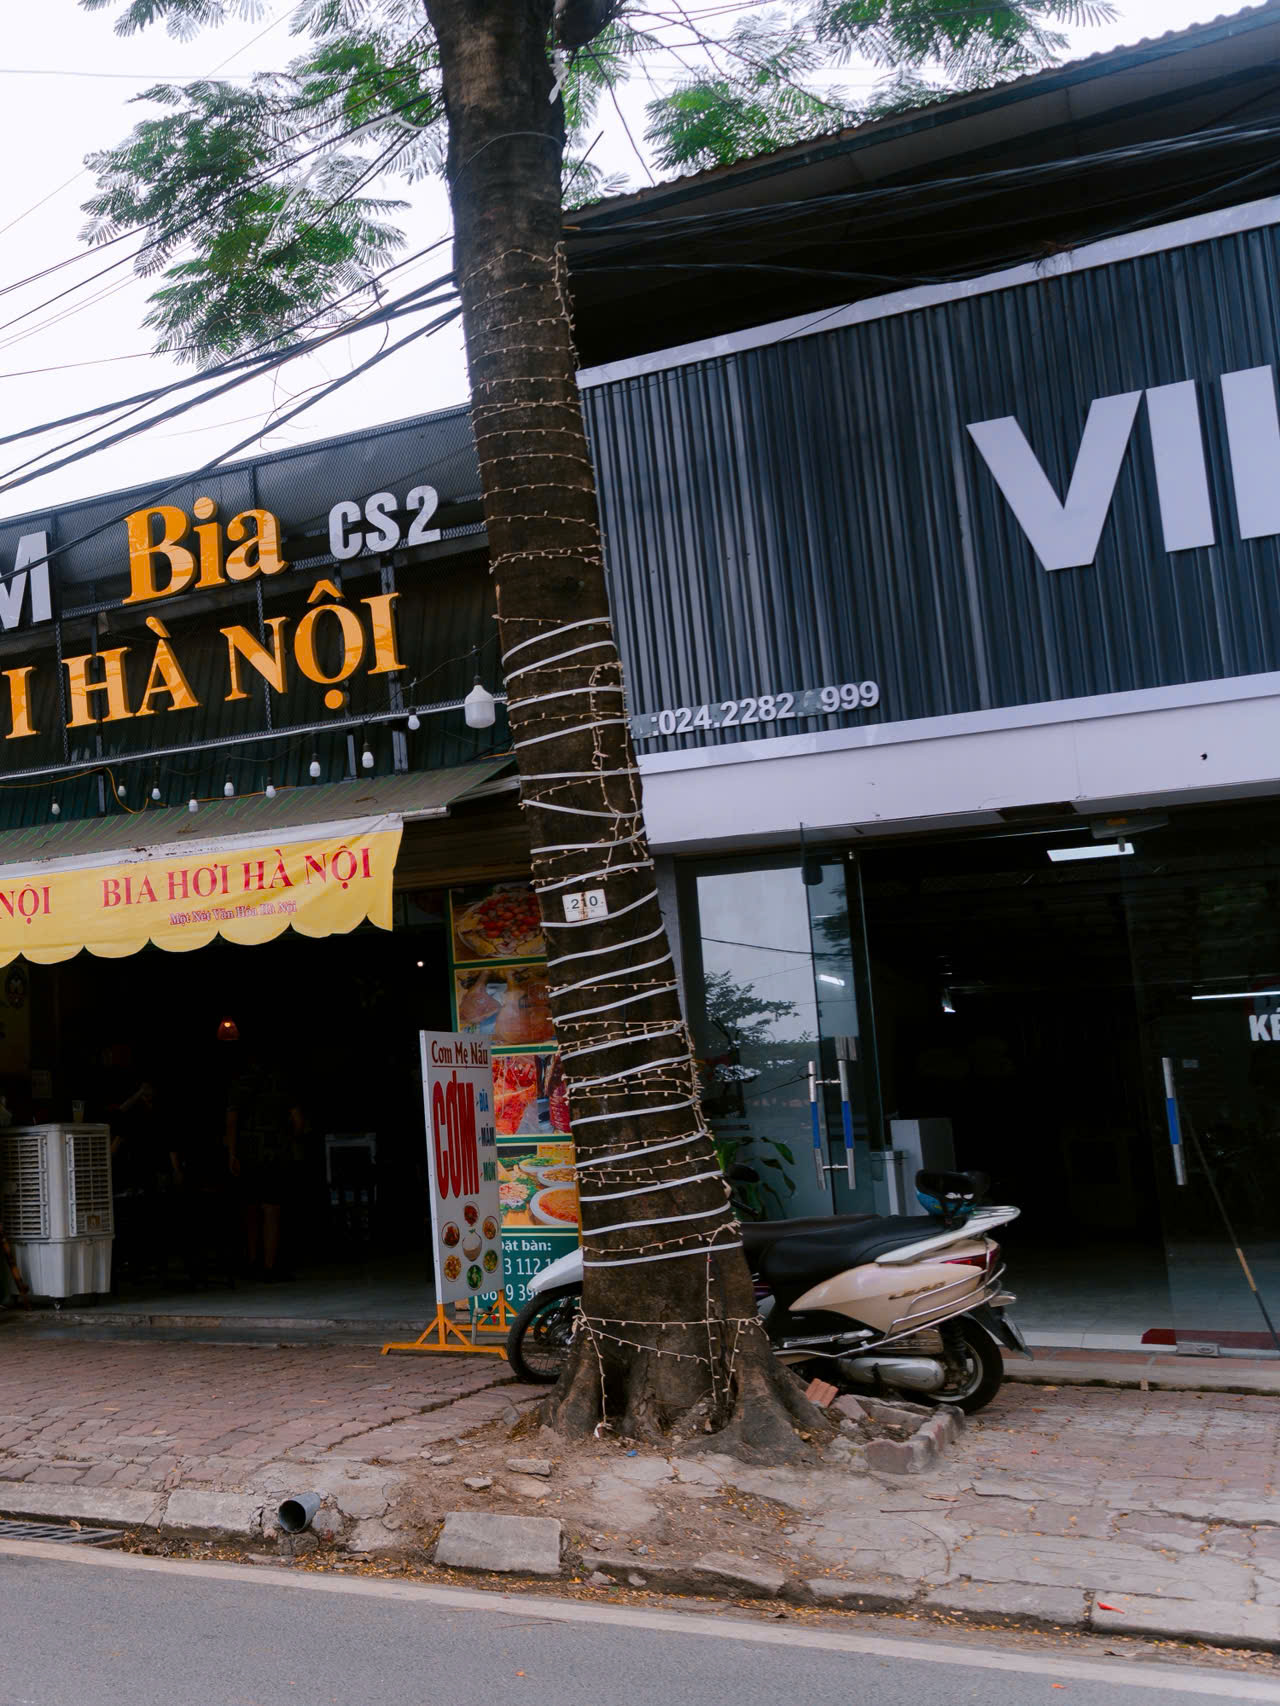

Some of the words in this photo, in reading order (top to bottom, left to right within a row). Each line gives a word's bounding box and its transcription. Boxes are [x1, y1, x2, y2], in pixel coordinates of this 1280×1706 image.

[121, 497, 290, 604] Bia
[328, 485, 442, 559] CS2
[62, 616, 203, 728] HÀ
[220, 579, 408, 710] NỘI
[821, 681, 880, 713] 999
[101, 874, 159, 908] BIA
[167, 864, 231, 901] HƠI
[241, 848, 294, 892] HÀ
[304, 845, 374, 890] NỘI
[433, 1070, 480, 1200] CƠM
[522, 1239, 552, 1251] bàn:
